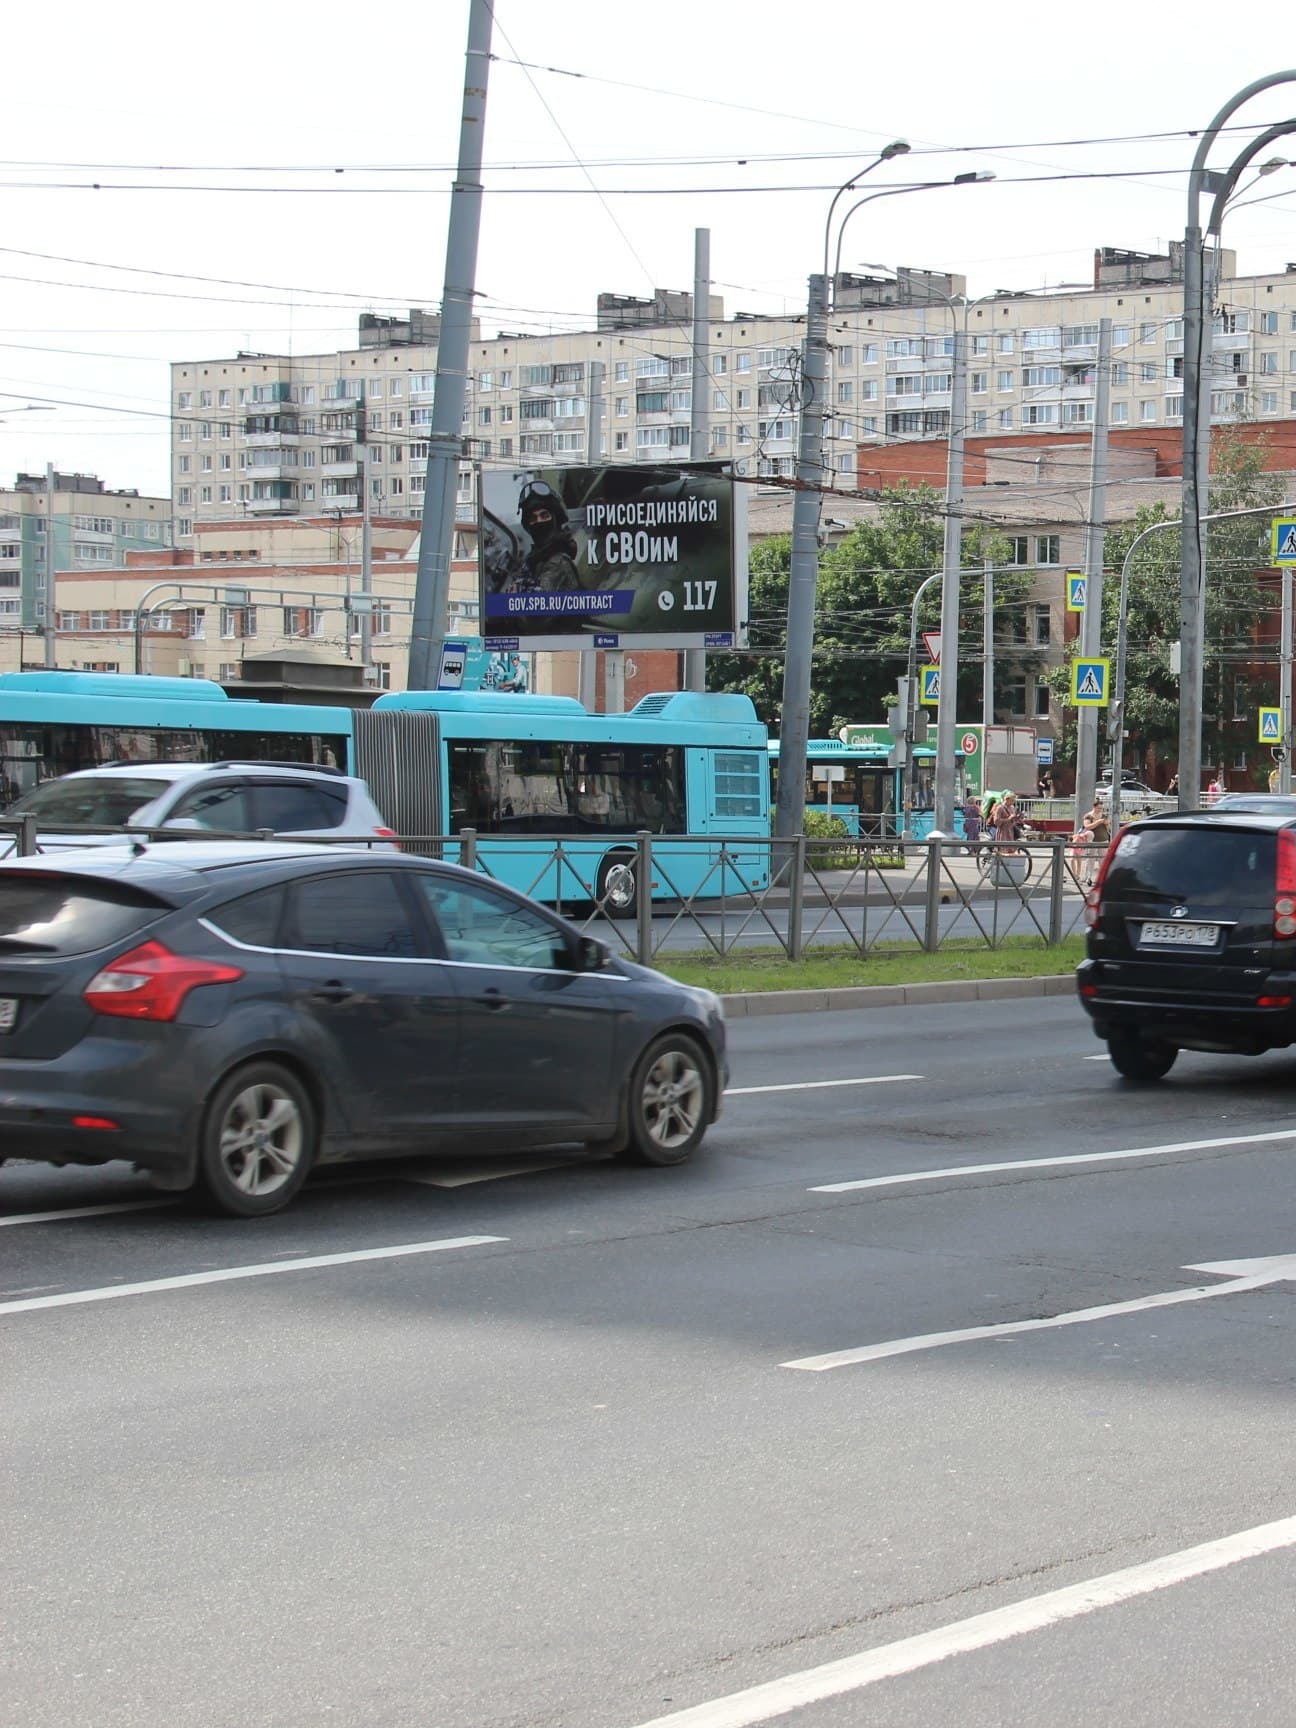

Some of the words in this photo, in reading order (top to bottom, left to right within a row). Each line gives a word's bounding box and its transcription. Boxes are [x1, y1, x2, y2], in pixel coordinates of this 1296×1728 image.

[586, 496, 718, 527] ПРИСОЕДИНЯЙСЯ
[508, 594, 614, 612] GOV.SPB.RU/CONTRACT
[683, 580, 718, 611] 117
